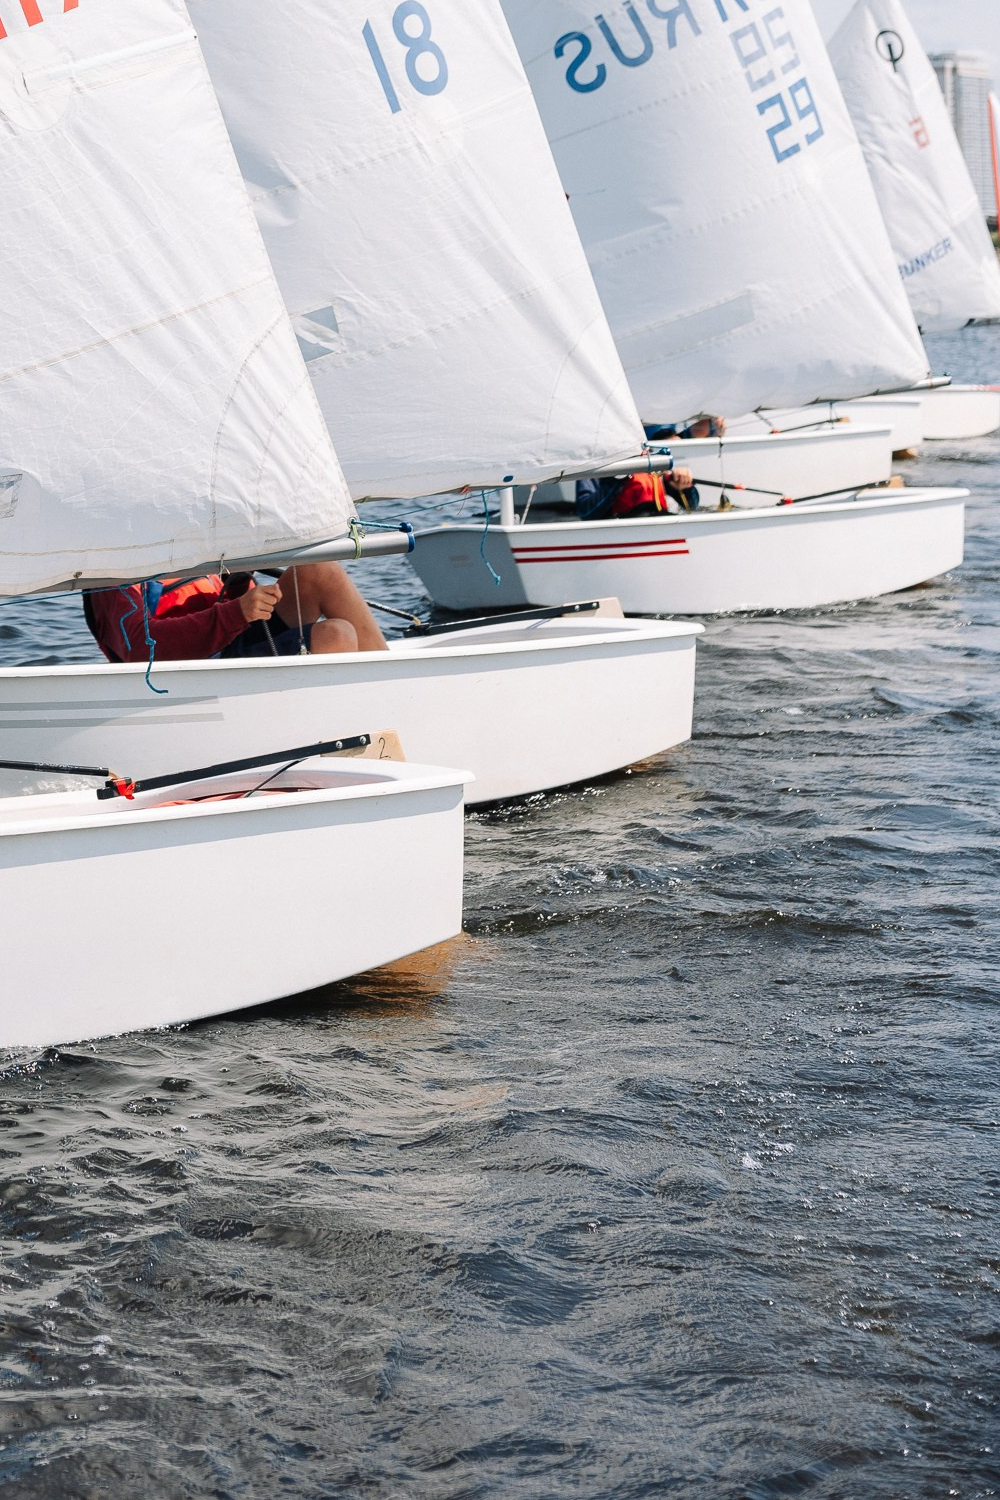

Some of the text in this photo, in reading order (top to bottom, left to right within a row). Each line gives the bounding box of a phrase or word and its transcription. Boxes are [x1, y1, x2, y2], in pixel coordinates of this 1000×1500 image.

[362, 0, 449, 114] 18
[756, 77, 824, 163] 29
[378, 736, 392, 760] 2
